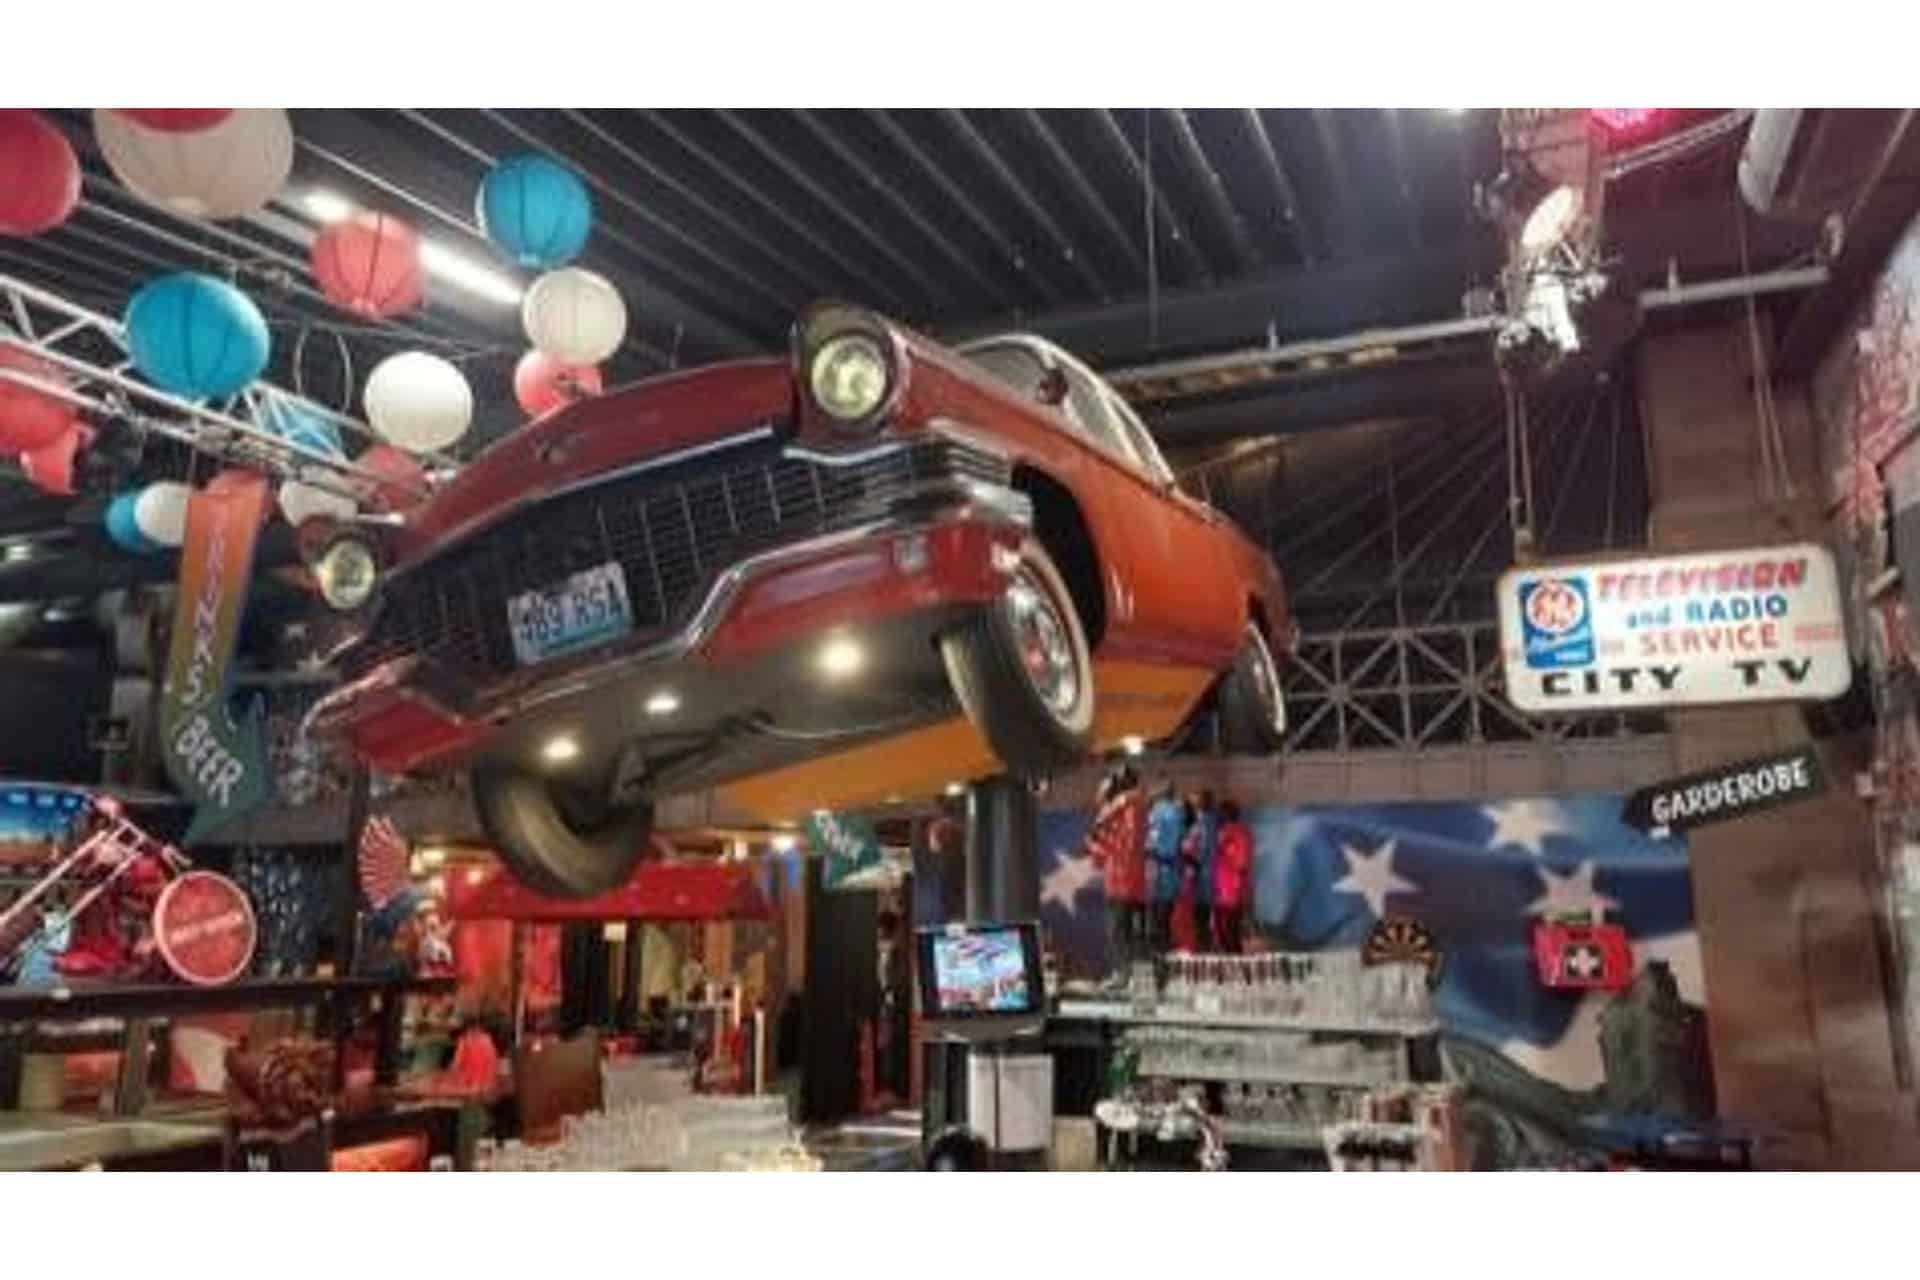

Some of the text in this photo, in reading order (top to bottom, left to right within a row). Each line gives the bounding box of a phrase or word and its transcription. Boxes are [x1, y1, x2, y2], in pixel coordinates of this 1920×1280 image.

[1597, 560, 1807, 600] TELEVISION
[1627, 594, 1788, 627] and RADIO
[1638, 621, 1779, 655] SERVICE
[1541, 656, 1812, 696] CITY TV
[176, 716, 243, 807] BEER
[1650, 757, 1809, 824] GARDEROBE
